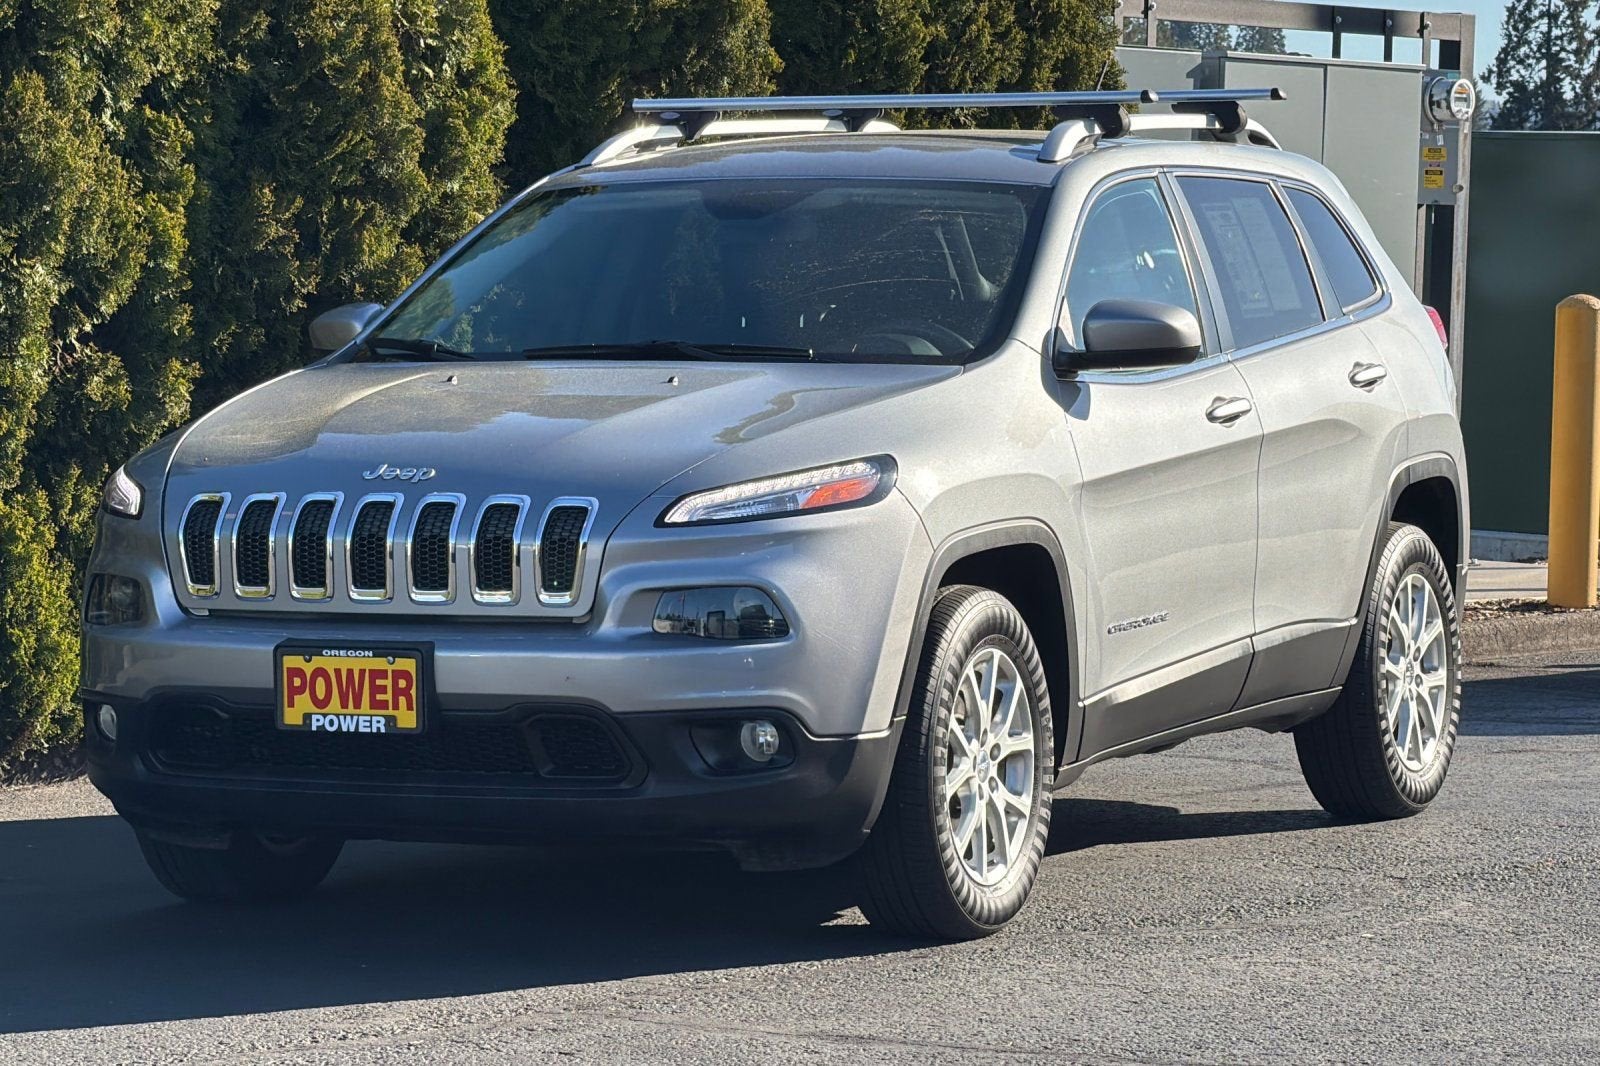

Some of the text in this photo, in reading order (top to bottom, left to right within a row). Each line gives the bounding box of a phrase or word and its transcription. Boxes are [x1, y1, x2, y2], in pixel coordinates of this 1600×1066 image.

[362, 463, 436, 483] Jeep
[1107, 612, 1169, 635] CHEROKEE
[322, 649, 373, 658] OREGON
[286, 666, 415, 711] POWER
[311, 714, 386, 733] POWER
